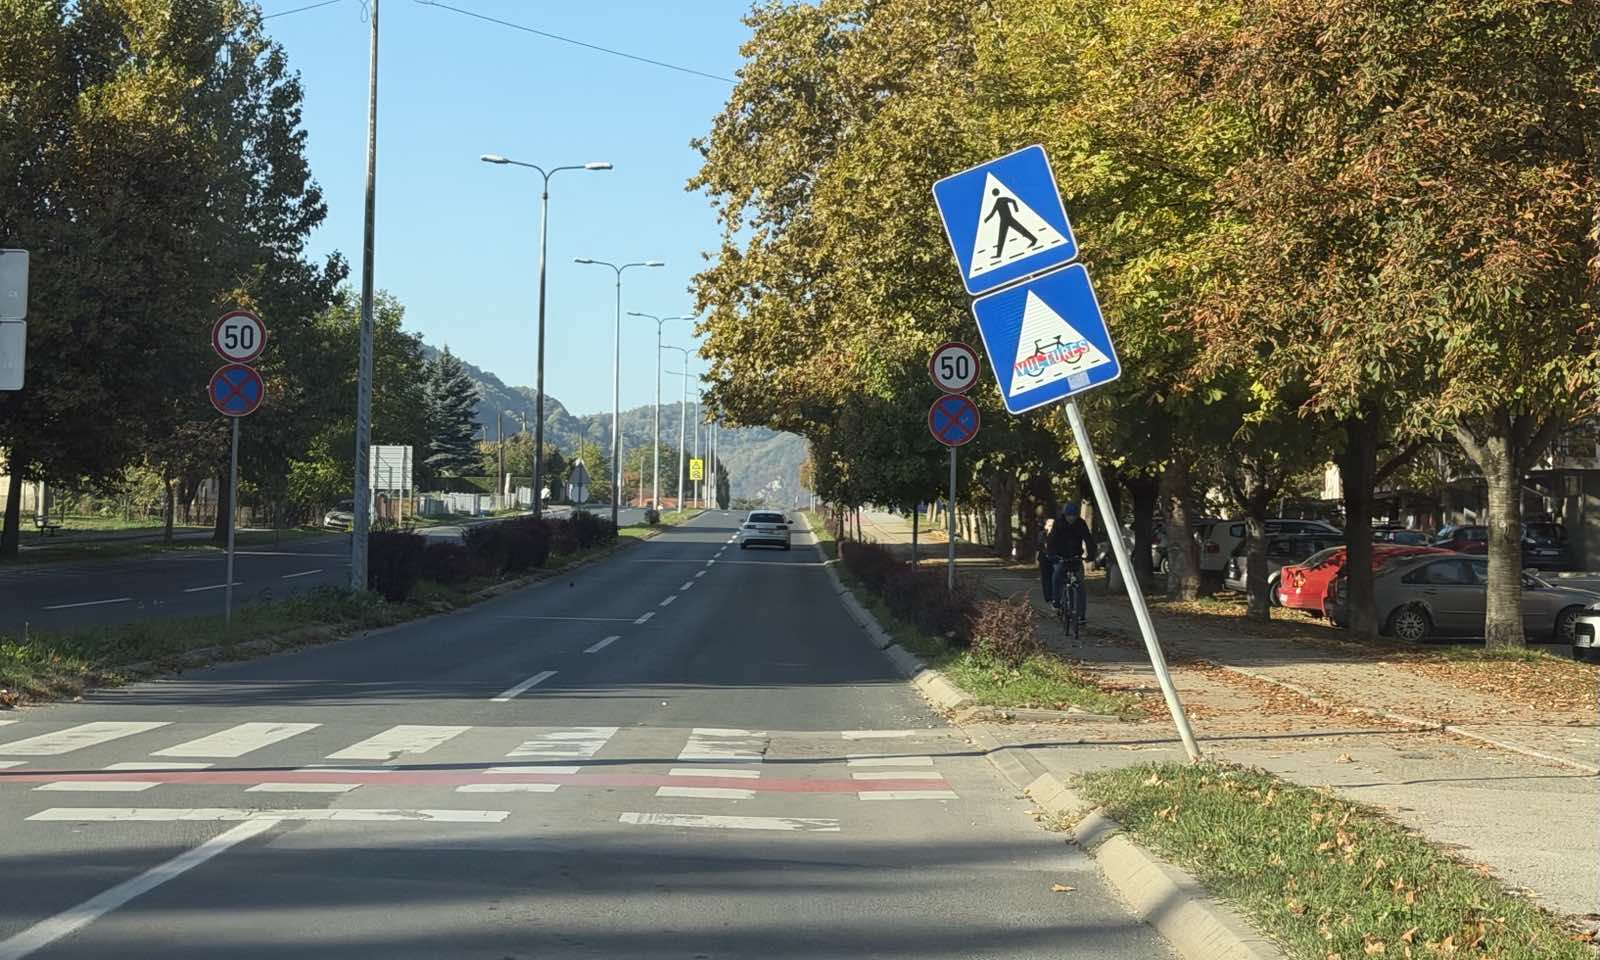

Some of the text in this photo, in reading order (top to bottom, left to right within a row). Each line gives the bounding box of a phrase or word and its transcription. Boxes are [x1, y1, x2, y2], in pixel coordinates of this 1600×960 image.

[225, 325, 254, 349] 50
[941, 355, 969, 380] 50
[1015, 339, 1089, 377] VULTURES
